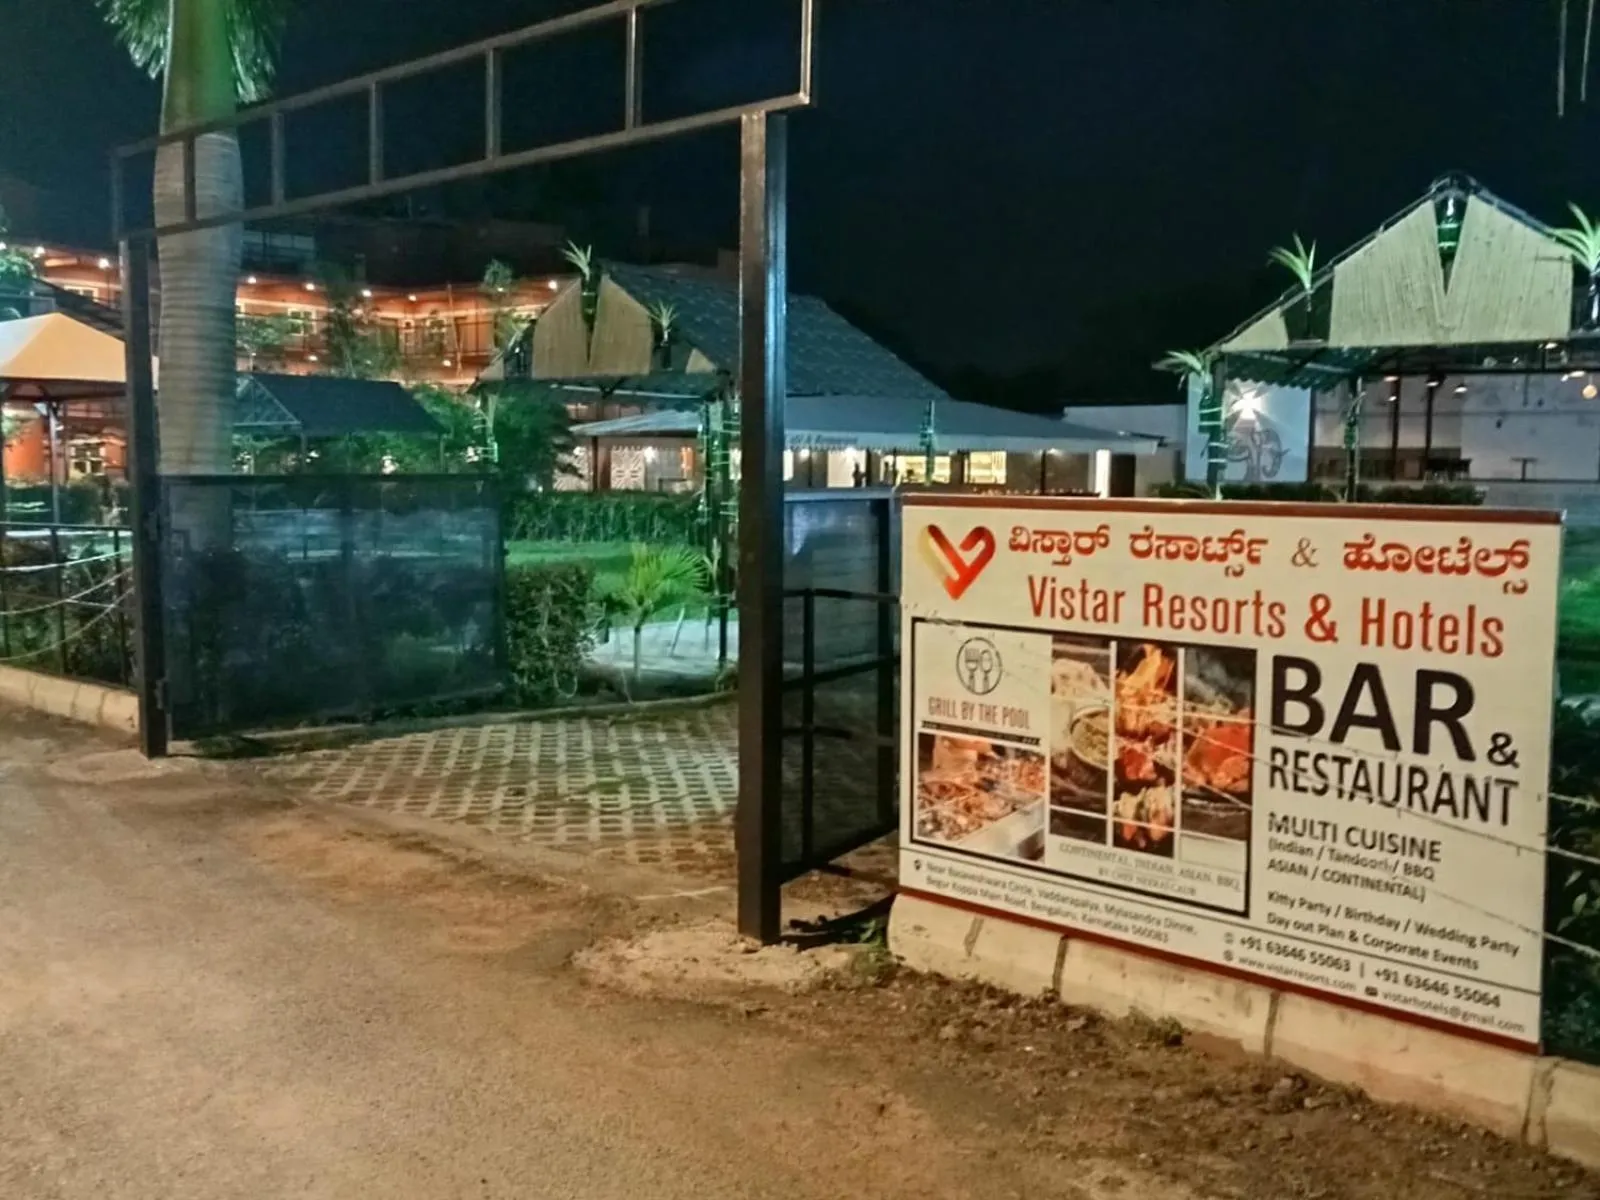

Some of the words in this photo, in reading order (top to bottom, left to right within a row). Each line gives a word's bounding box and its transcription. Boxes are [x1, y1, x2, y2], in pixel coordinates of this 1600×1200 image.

[1008, 524, 1110, 566] ವಿಸ್ತಾರ್
[1291, 537, 1320, 568] &
[1343, 532, 1531, 594] ಹೋಟೆಲ್ಸ್
[1027, 574, 1126, 625] Vistar
[1142, 582, 1286, 639] Resorts
[1304, 593, 1339, 643] &
[1360, 597, 1504, 658] Hotels
[928, 696, 956, 717] GRILL
[961, 701, 974, 720] BY
[978, 703, 997, 724] THE
[1001, 706, 1029, 728] POOL
[1270, 654, 1476, 762] BAR
[1486, 732, 1519, 768] &
[1269, 746, 1519, 826] RESTAURANT
[1267, 858, 1307, 876] ASIAN
[1310, 866, 1319, 880] /
[1268, 813, 1338, 842] MULTI
[1344, 827, 1442, 861] CUISINE
[1316, 845, 1325, 860] /
[1402, 862, 1434, 881] BBQ
[1267, 891, 1295, 907] Kitty
[1298, 898, 1331, 916] Party
[1334, 904, 1341, 918] /
[1344, 906, 1400, 931] Birthday
[1402, 918, 1411, 933] /
[1413, 922, 1475, 946] Wedding
[1480, 935, 1520, 957] Party
[1267, 912, 1290, 928] Day
[1292, 918, 1314, 932] out
[1317, 924, 1345, 939] Plan
[1348, 930, 1358, 942] &
[1363, 934, 1429, 958] Corporate
[1433, 948, 1480, 970] Events
[1239, 935, 1262, 950] +91
[1266, 941, 1305, 960] 63646
[1309, 951, 1350, 971] 55063
[1374, 966, 1399, 983] +91
[1404, 973, 1449, 994] 63646
[1453, 984, 1501, 1007] 55064
